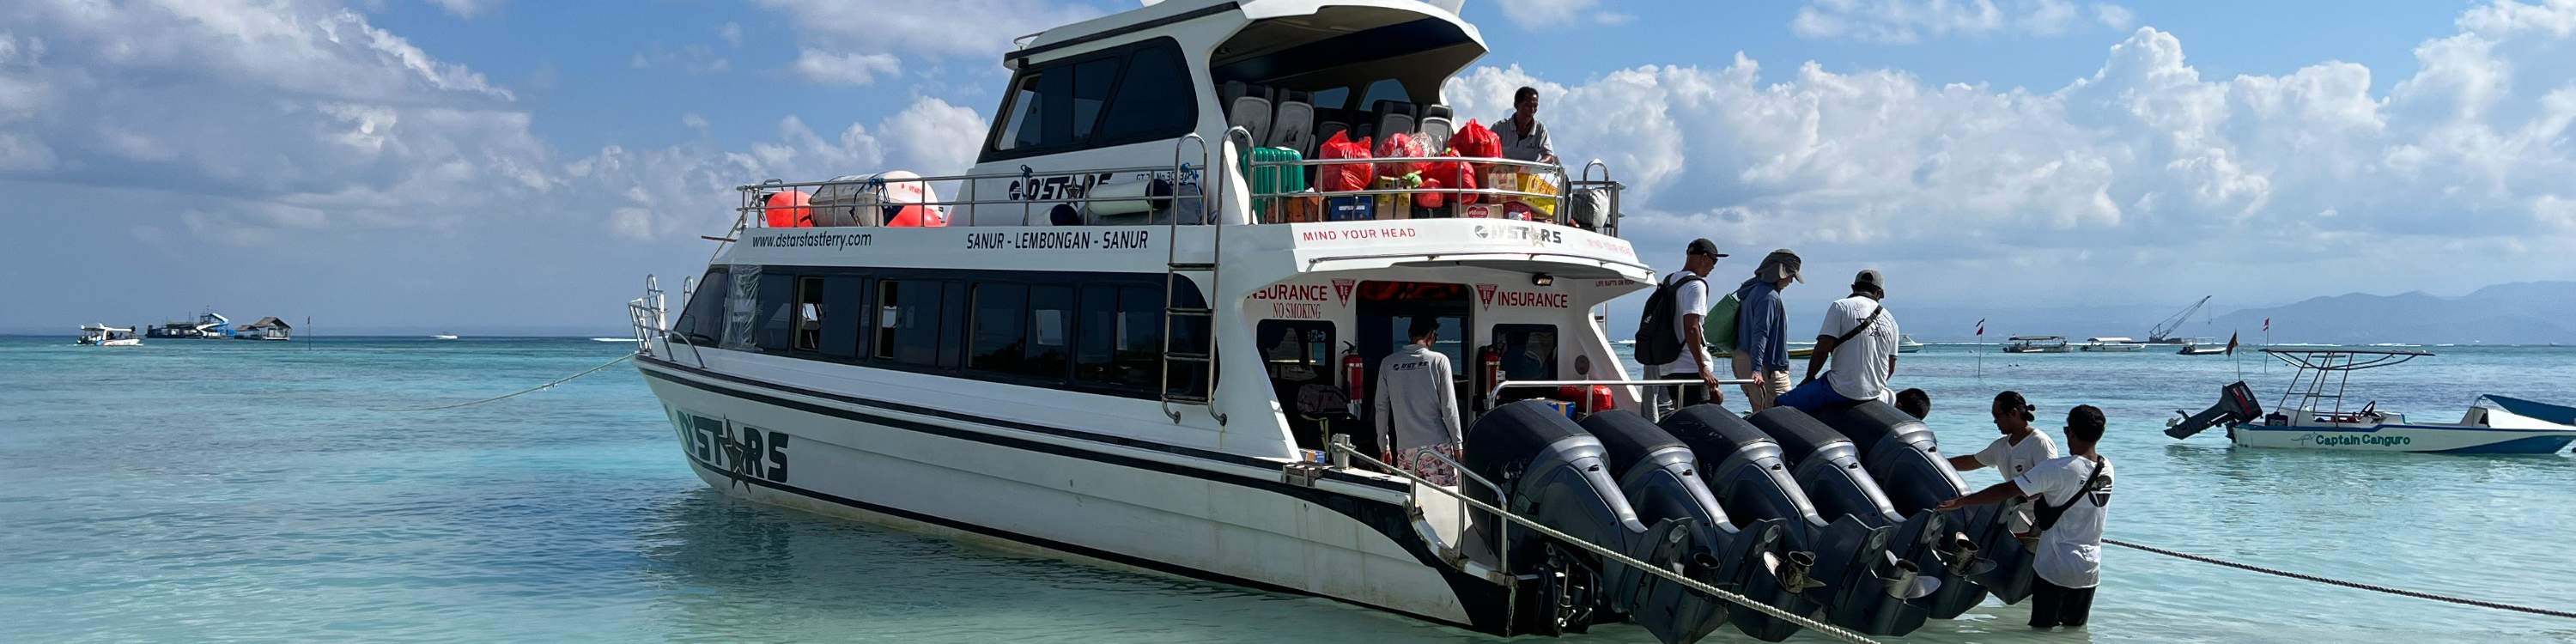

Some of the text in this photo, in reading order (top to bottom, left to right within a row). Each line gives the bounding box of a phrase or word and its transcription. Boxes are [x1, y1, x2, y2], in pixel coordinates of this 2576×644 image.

[752, 231, 872, 251] www.dstarsfastferry.com
[967, 233, 1004, 249] SANUR
[1015, 232, 1091, 249] LEMBONGAN
[1103, 230, 1148, 249] SANUR
[1303, 228, 1416, 241] MIND YOUR HEAD
[1498, 292, 1568, 308] INSURANCE
[1273, 303, 1321, 319] NO SMOKING
[2316, 434, 2410, 447] Captain Canguro
